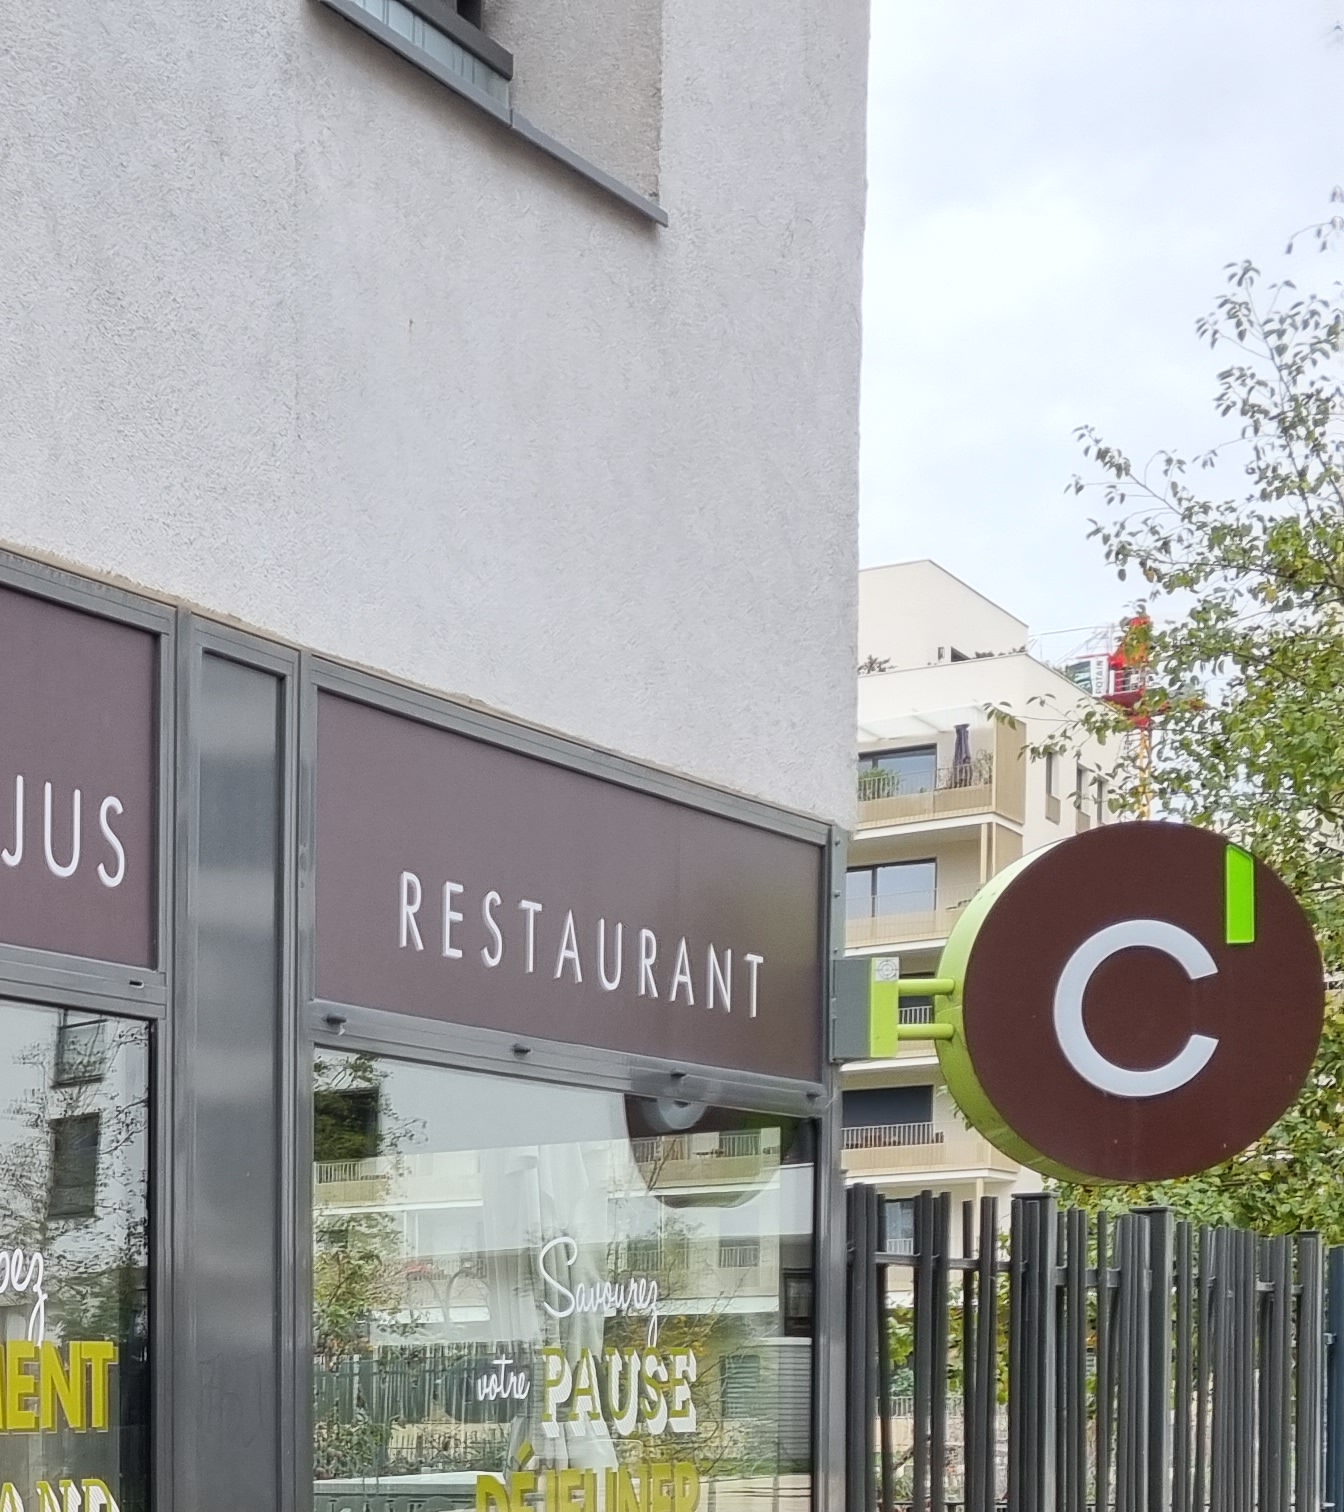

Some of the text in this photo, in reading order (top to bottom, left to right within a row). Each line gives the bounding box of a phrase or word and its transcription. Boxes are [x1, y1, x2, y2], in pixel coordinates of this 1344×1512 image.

[0, 772, 127, 889] JUS
[398, 869, 765, 1020] RESTAURANT
[539, 1237, 658, 1347] Savourez
[476, 1347, 696, 1437] votre PAUSE
